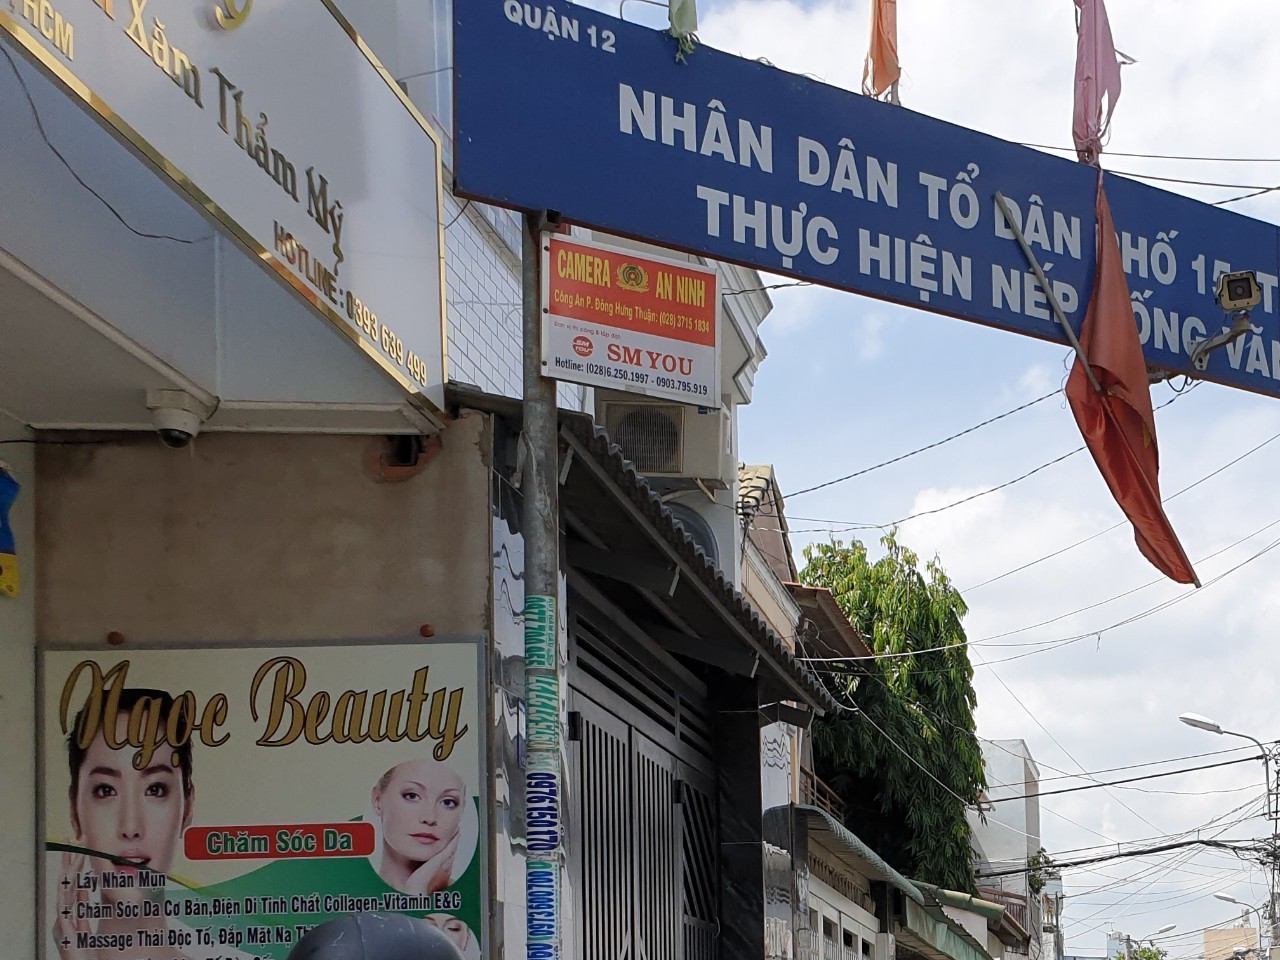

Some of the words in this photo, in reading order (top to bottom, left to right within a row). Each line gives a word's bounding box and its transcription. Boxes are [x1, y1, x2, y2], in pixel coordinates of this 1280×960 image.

[503, 0, 579, 41] QUẬN
[586, 25, 617, 53] 12
[619, 82, 773, 174] NHÂN
[798, 135, 898, 209] DÂN
[919, 162, 980, 230] TỔ
[994, 194, 1082, 260] DÂN
[305, 166, 344, 276] Mỹ
[557, 249, 611, 288] CAMERA
[655, 271, 673, 301] AN
[676, 276, 705, 308] NINH
[696, 185, 840, 269] THỰC
[858, 227, 973, 302] HIỆN
[991, 262, 1080, 325] NẾP
[554, 289, 574, 309] Công
[595, 297, 614, 317] Đông
[615, 301, 633, 321] Hưng
[635, 306, 658, 325] Thuận:
[659, 311, 676, 330] (028)
[677, 314, 693, 330] 3715
[694, 318, 710, 333] 1834
[346, 290, 379, 341] 0393
[381, 325, 404, 367] 639
[406, 349, 427, 387] 499
[607, 343, 643, 367] SM
[645, 350, 693, 376] YOU
[555, 356, 584, 372] Hotline:
[586, 362, 649, 385] (028)6.250.1997
[656, 376, 708, 396] 0903.795.919
[59, 659, 231, 770] Ngọc
[250, 656, 468, 761] Beauty
[205, 830, 270, 855] Chăm
[276, 829, 318, 853] Sóc
[323, 829, 352, 852] Da
[76, 871, 98, 892] Lấy
[102, 872, 135, 888] Nhân
[138, 872, 166, 891] Mụn
[76, 902, 112, 918] Chăm
[116, 900, 139, 918] Sóc
[143, 902, 160, 917] Da
[164, 900, 181, 917] Cơ
[245, 898, 257, 915] Di
[291, 892, 320, 913] Chất
[434, 891, 461, 909] E&C
[76, 932, 133, 949] Massage
[137, 929, 165, 947] Thải
[168, 929, 192, 949] Độc
[195, 927, 215, 948] Tố,
[218, 926, 243, 948] Đắp
[247, 926, 272, 948] Mặt
[275, 926, 292, 947] Nạ
